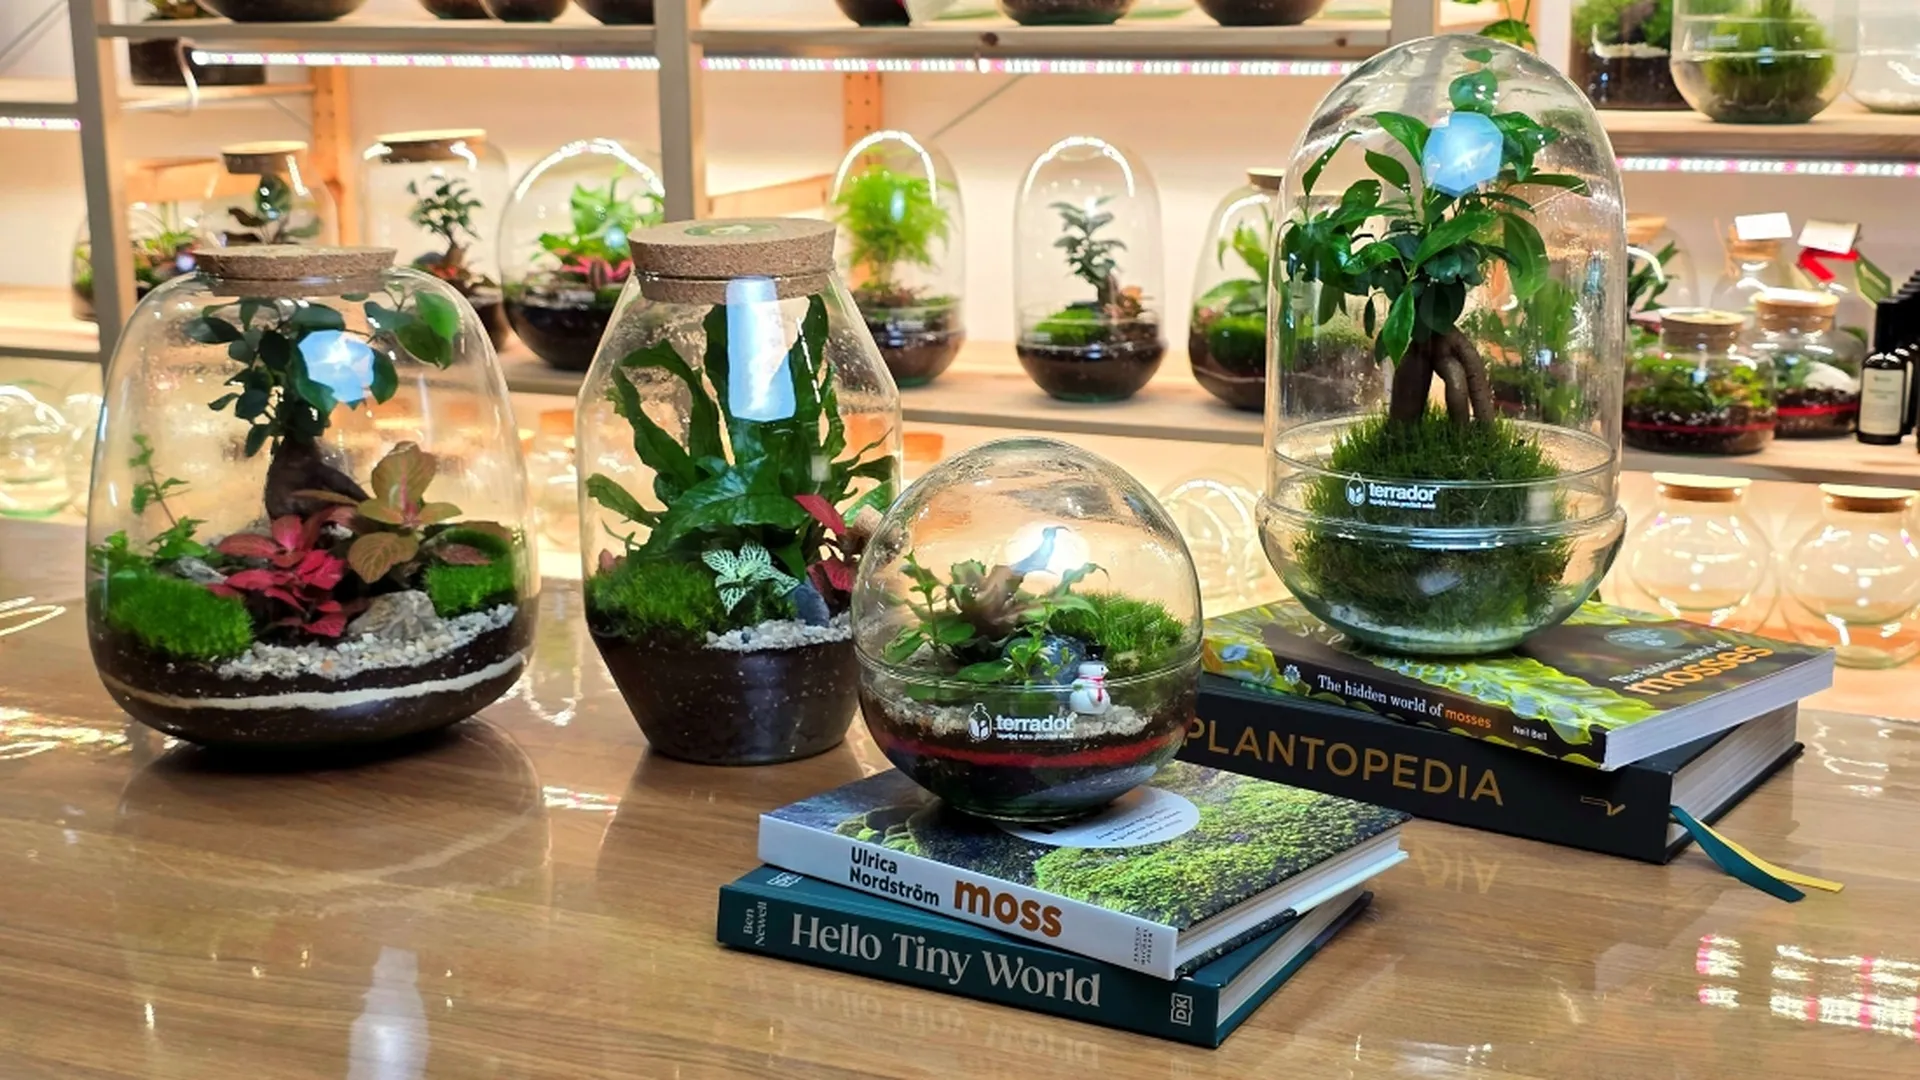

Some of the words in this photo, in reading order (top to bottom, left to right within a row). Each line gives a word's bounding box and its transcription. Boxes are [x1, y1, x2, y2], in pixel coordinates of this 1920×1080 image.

[1369, 483, 1438, 502] terrador
[1624, 645, 1774, 696] mosses
[1317, 674, 1342, 694] The
[1344, 680, 1387, 704] hidden
[1390, 695, 1426, 713] world
[1428, 703, 1445, 718] of
[1445, 709, 1492, 729] mosses
[996, 715, 1073, 732] terrador
[1183, 716, 1504, 806] PLANTOPEDIA
[851, 846, 898, 875] Ulrica
[849, 866, 940, 907] Nordström
[743, 908, 755, 935] Ben
[754, 901, 768, 946] Newell
[954, 879, 1063, 938] moss
[791, 913, 882, 962] Hello
[892, 932, 972, 985] Tiny
[982, 950, 1101, 1008] World
[1175, 998, 1188, 1021] DK
